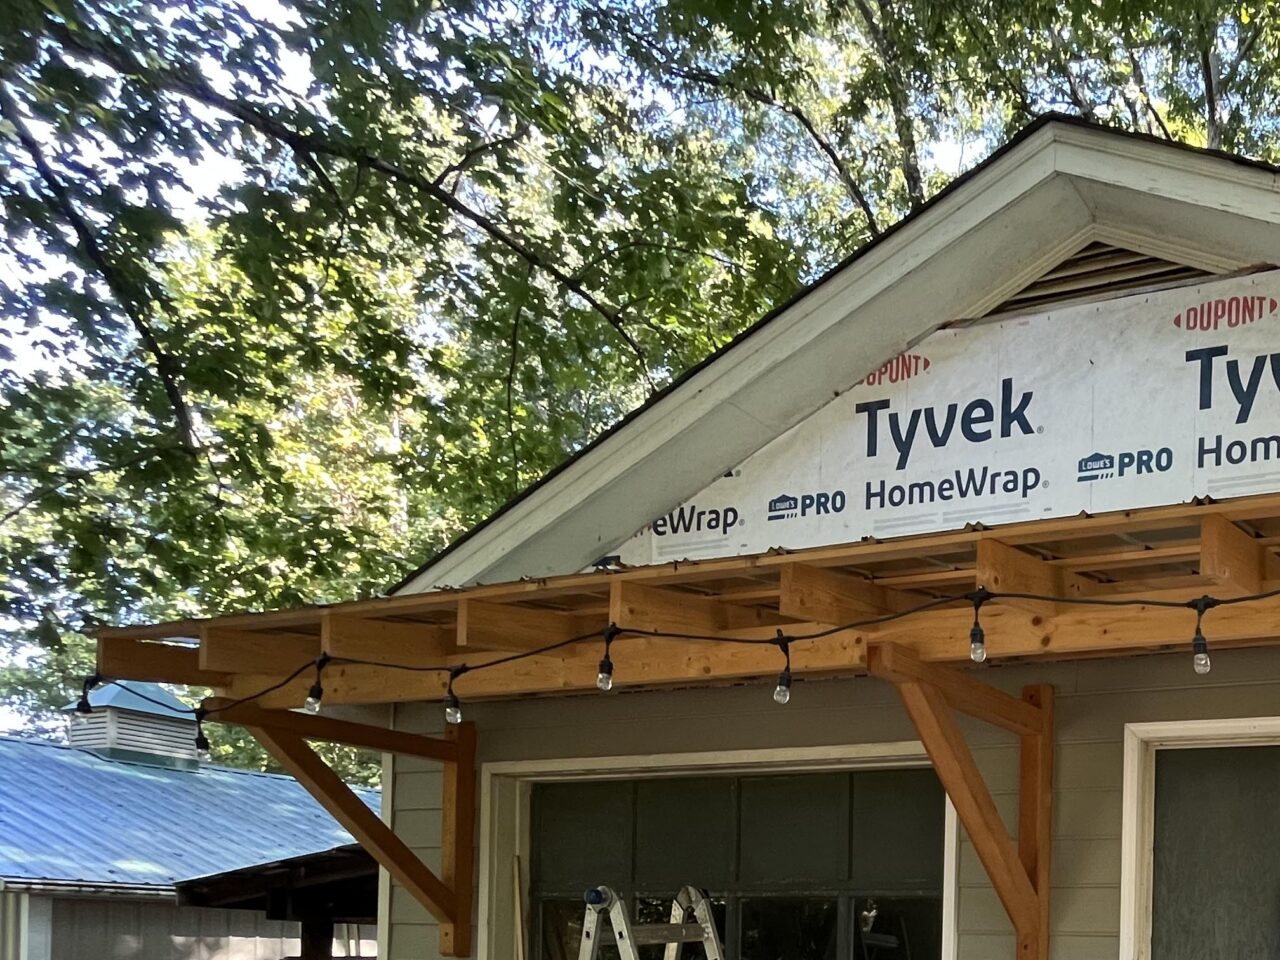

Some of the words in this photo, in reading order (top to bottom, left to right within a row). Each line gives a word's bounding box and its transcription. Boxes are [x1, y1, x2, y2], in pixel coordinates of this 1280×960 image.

[1186, 296, 1267, 331] DUPONT
[857, 354, 921, 386] PONT
[855, 377, 1035, 471] Tyvek
[1118, 447, 1173, 477] PRO
[801, 490, 846, 517] PRO
[865, 466, 1041, 511] HomeWrap
